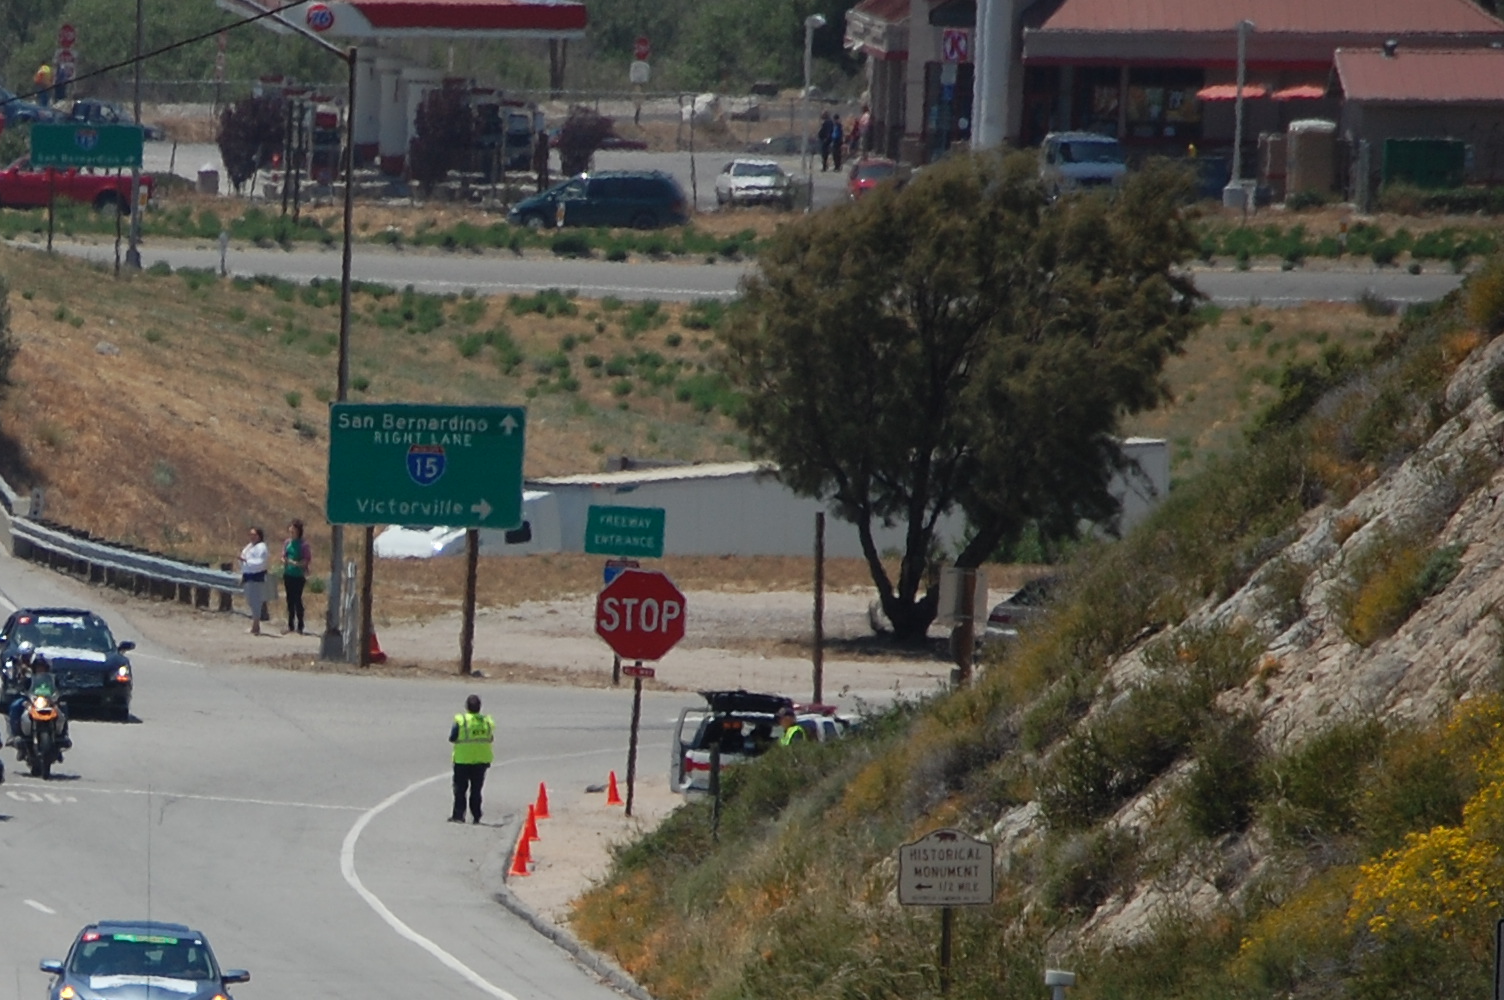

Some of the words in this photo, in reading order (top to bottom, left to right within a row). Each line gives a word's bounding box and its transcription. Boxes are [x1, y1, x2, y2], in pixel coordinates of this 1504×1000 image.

[309, 7, 331, 28] 76
[338, 412, 375, 430] San
[381, 412, 489, 433] Bernardino
[374, 430, 422, 445] RIGHT
[431, 432, 473, 447] LANE
[414, 457, 439, 479] 15
[356, 497, 465, 516] Victorville
[599, 514, 652, 530] FREEWAY
[593, 534, 656, 549] ENTRANCE
[598, 596, 682, 635] STOP
[909, 848, 982, 861] HISTORICAL
[914, 866, 979, 877] MONUMENT
[958, 883, 979, 892] MILE
